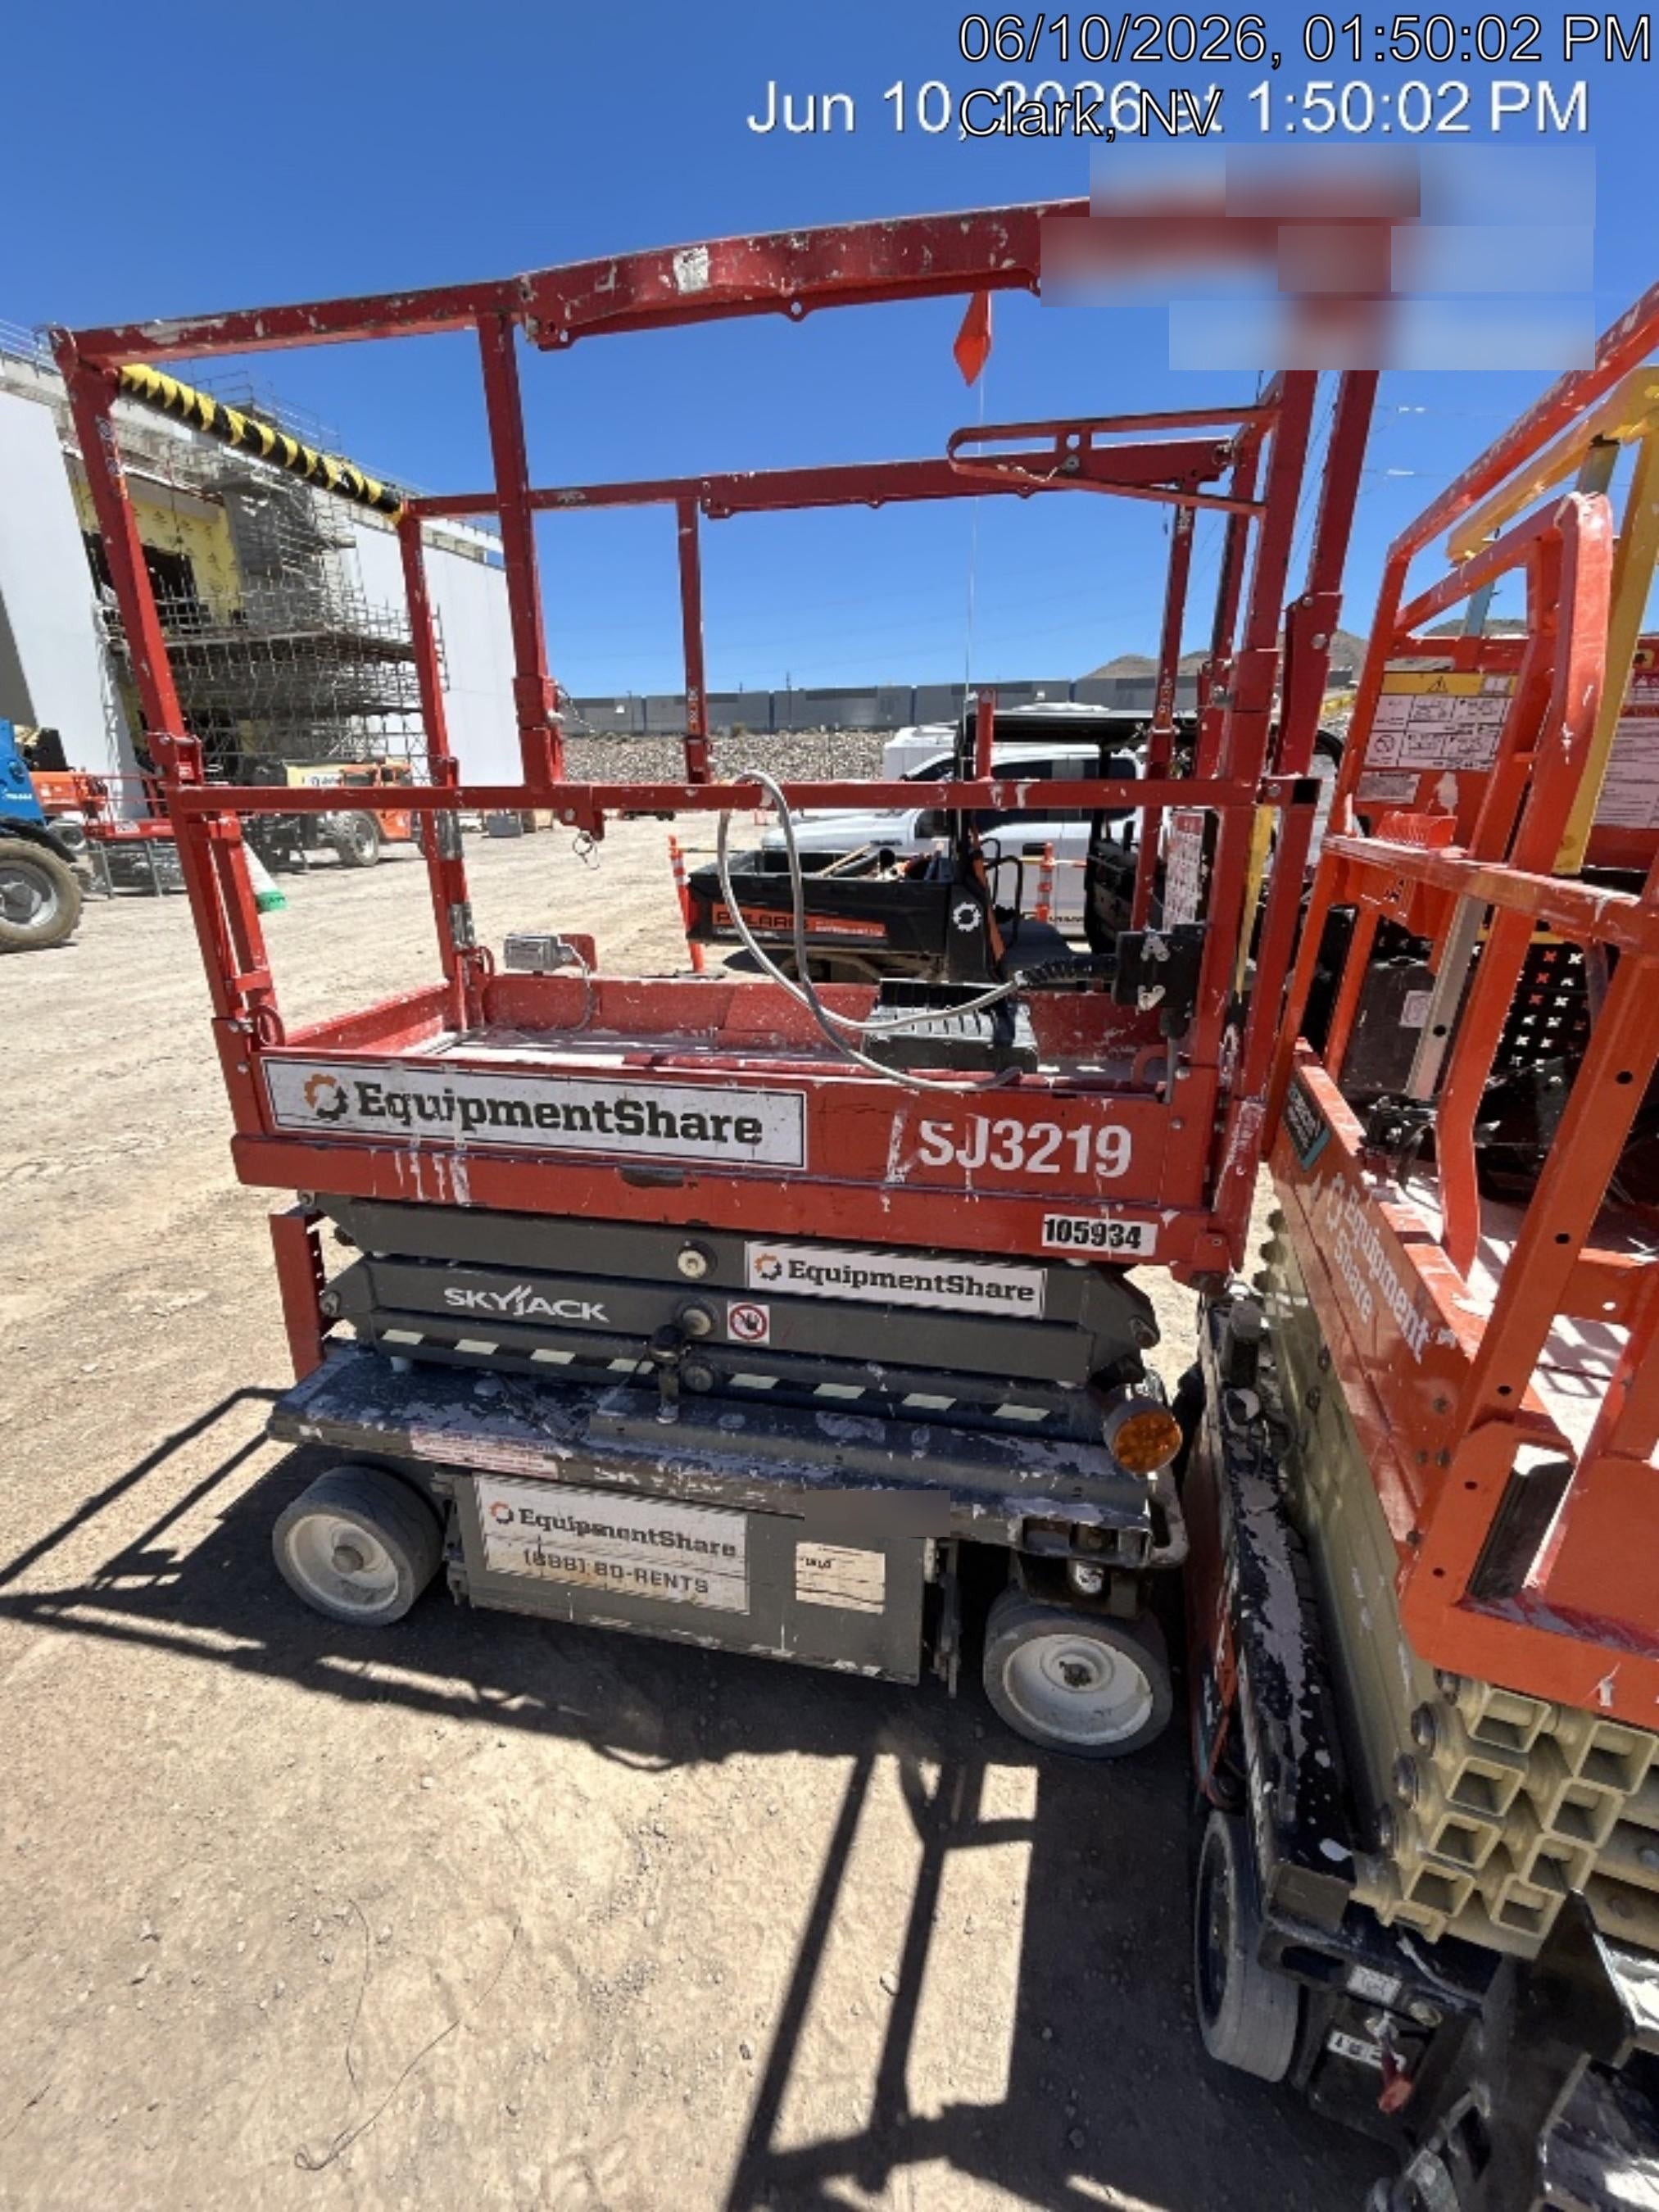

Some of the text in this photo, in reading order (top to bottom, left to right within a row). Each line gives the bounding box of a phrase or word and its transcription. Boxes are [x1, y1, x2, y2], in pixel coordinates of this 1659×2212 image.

[353, 1079, 763, 1145] EquipmentShare
[918, 1114, 1132, 1178] SJ3219
[1045, 1218, 1142, 1249] 105934
[443, 1284, 610, 1323] SKYJACK
[787, 1259, 1035, 1303] EquipmentShare
[518, 1507, 737, 1557] EquipmentShare
